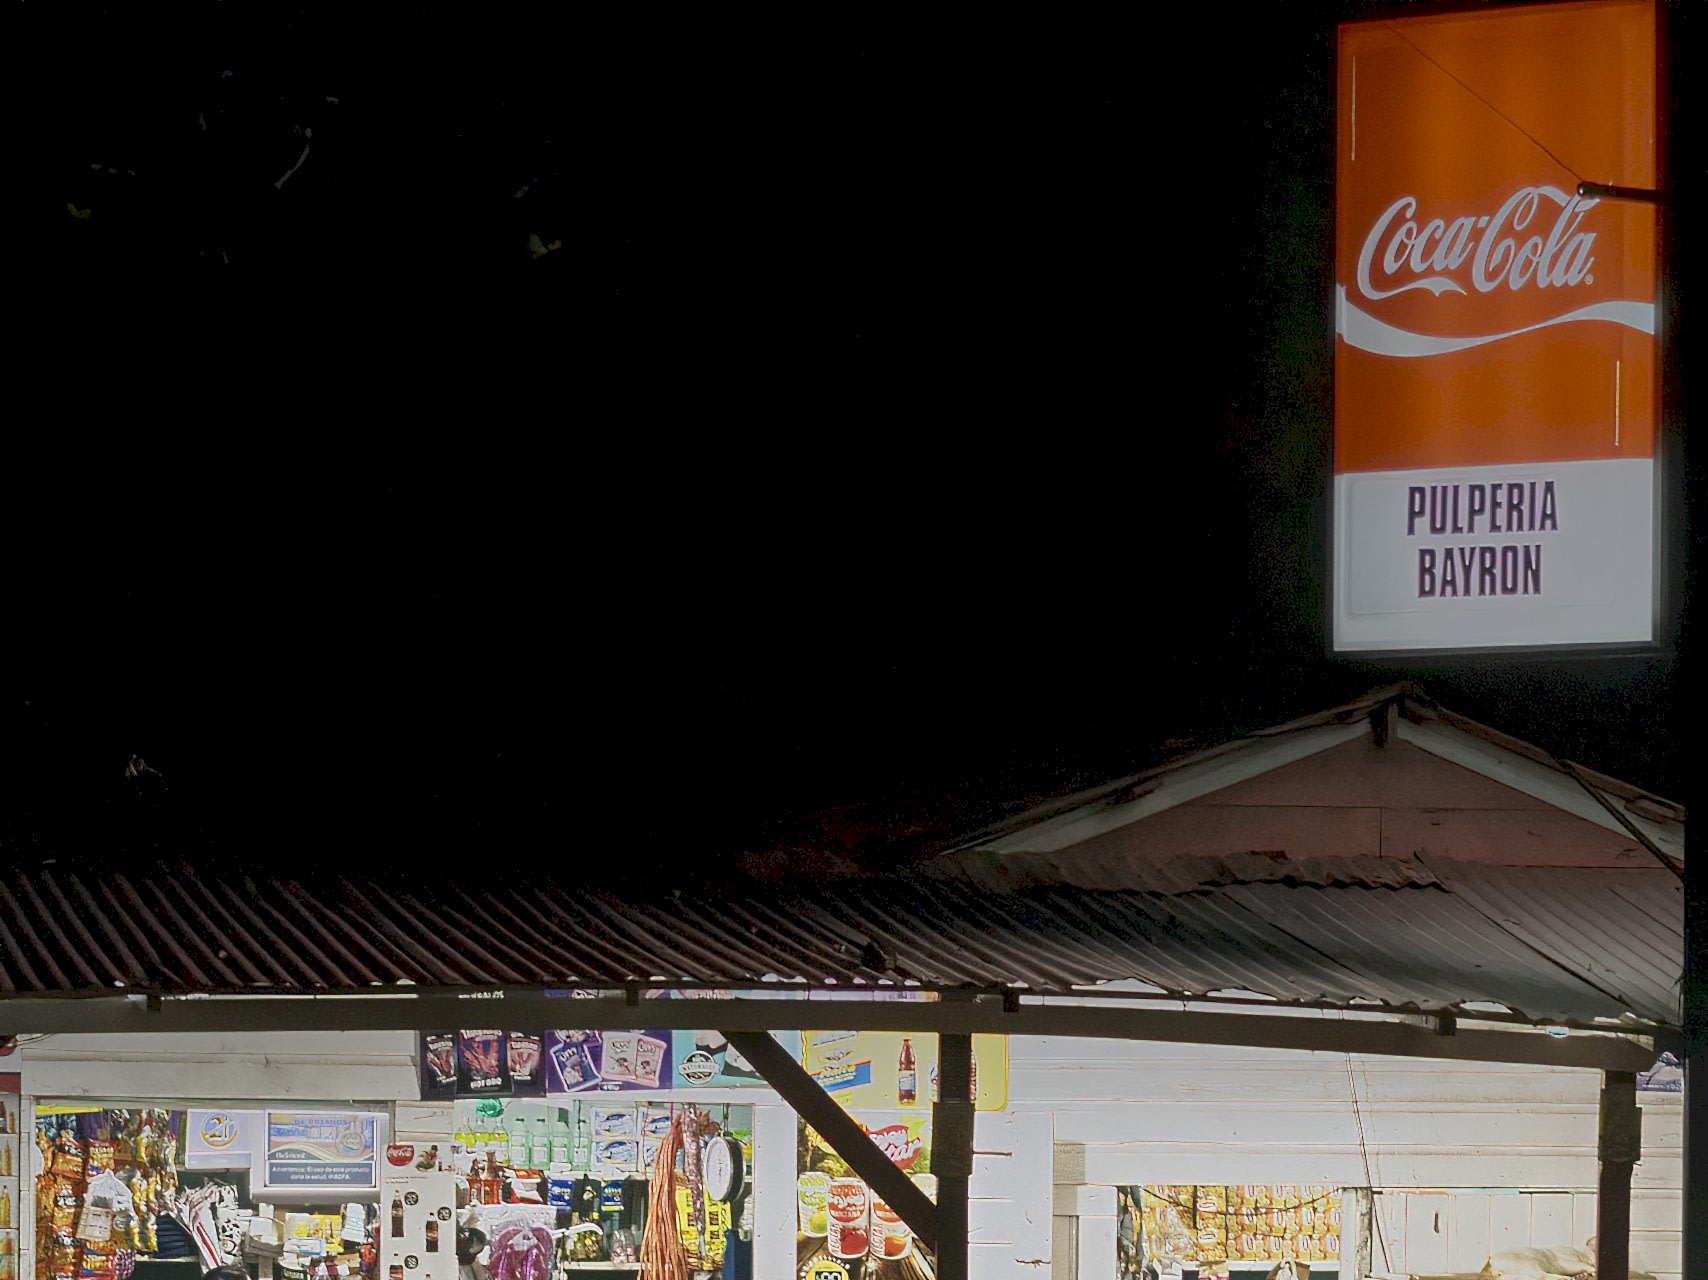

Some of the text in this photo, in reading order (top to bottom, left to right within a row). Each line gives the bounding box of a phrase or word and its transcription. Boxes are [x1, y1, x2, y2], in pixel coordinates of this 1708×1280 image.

[1356, 185, 1600, 299] Coca-Cola
[1407, 480, 1559, 537] PULPERIA
[1418, 544, 1542, 599] BAYRON
